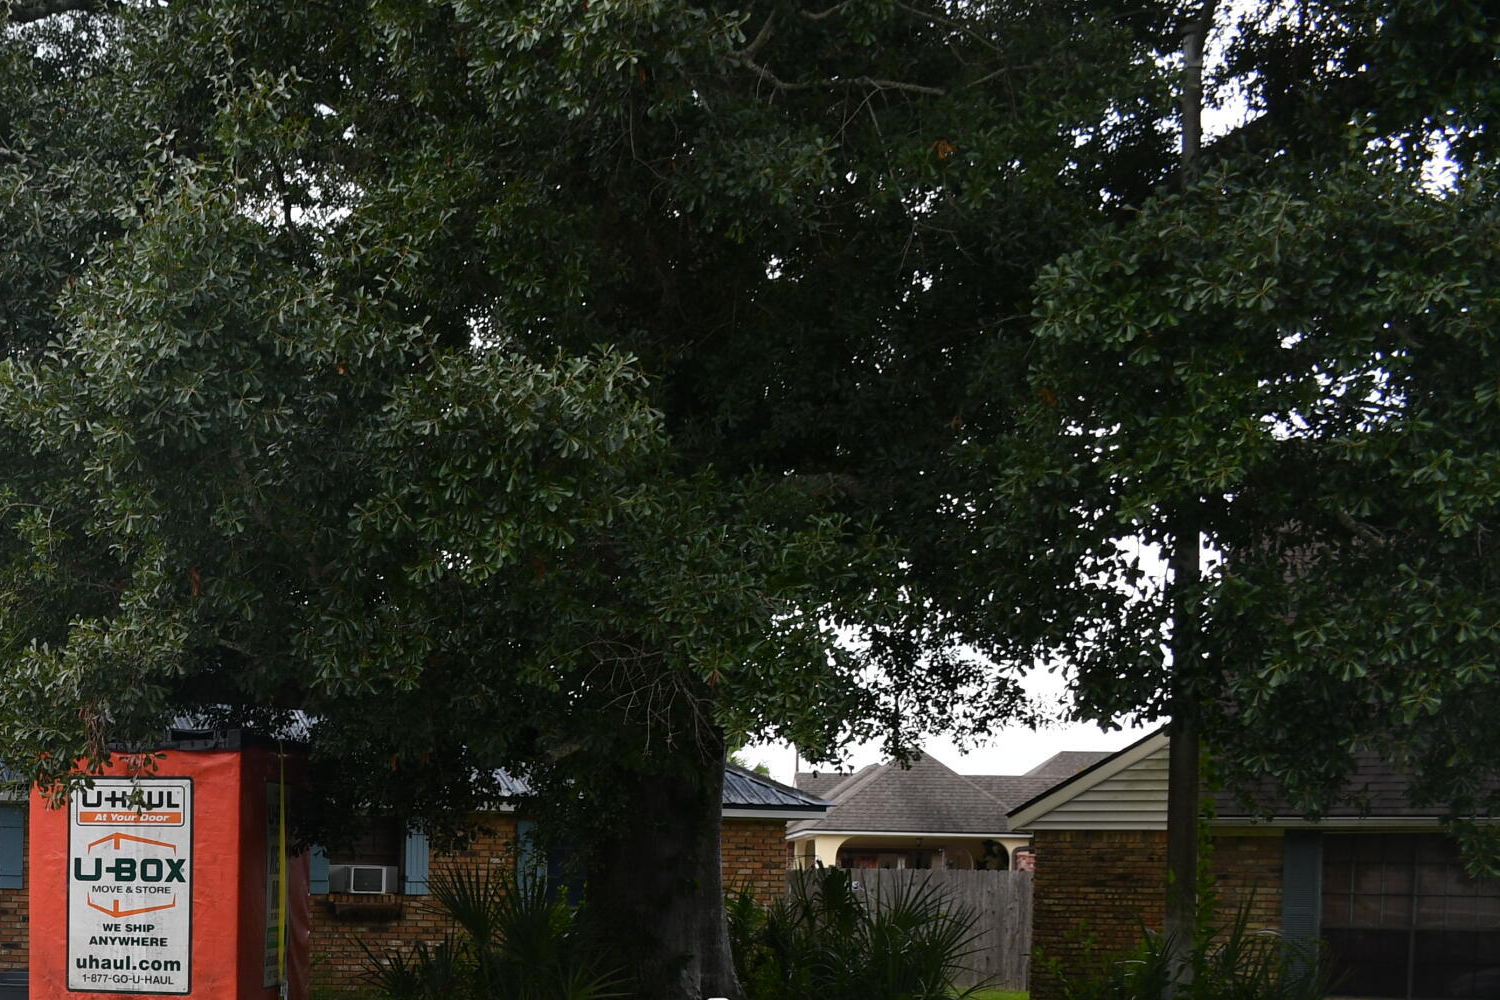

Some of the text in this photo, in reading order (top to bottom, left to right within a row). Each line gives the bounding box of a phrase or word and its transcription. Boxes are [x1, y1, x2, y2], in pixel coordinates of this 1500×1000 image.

[82, 791, 180, 808] U-HUL
[94, 813, 171, 822] At Your Door
[74, 858, 186, 883] U-BOX
[92, 886, 123, 894] MOVE
[135, 886, 172, 894] STORE
[102, 923, 155, 932] WE SHIP
[89, 936, 169, 947] ANYWHERE
[76, 954, 181, 972] uhaul.com
[82, 974, 174, 985] 1-877-GO-U-HAUL
